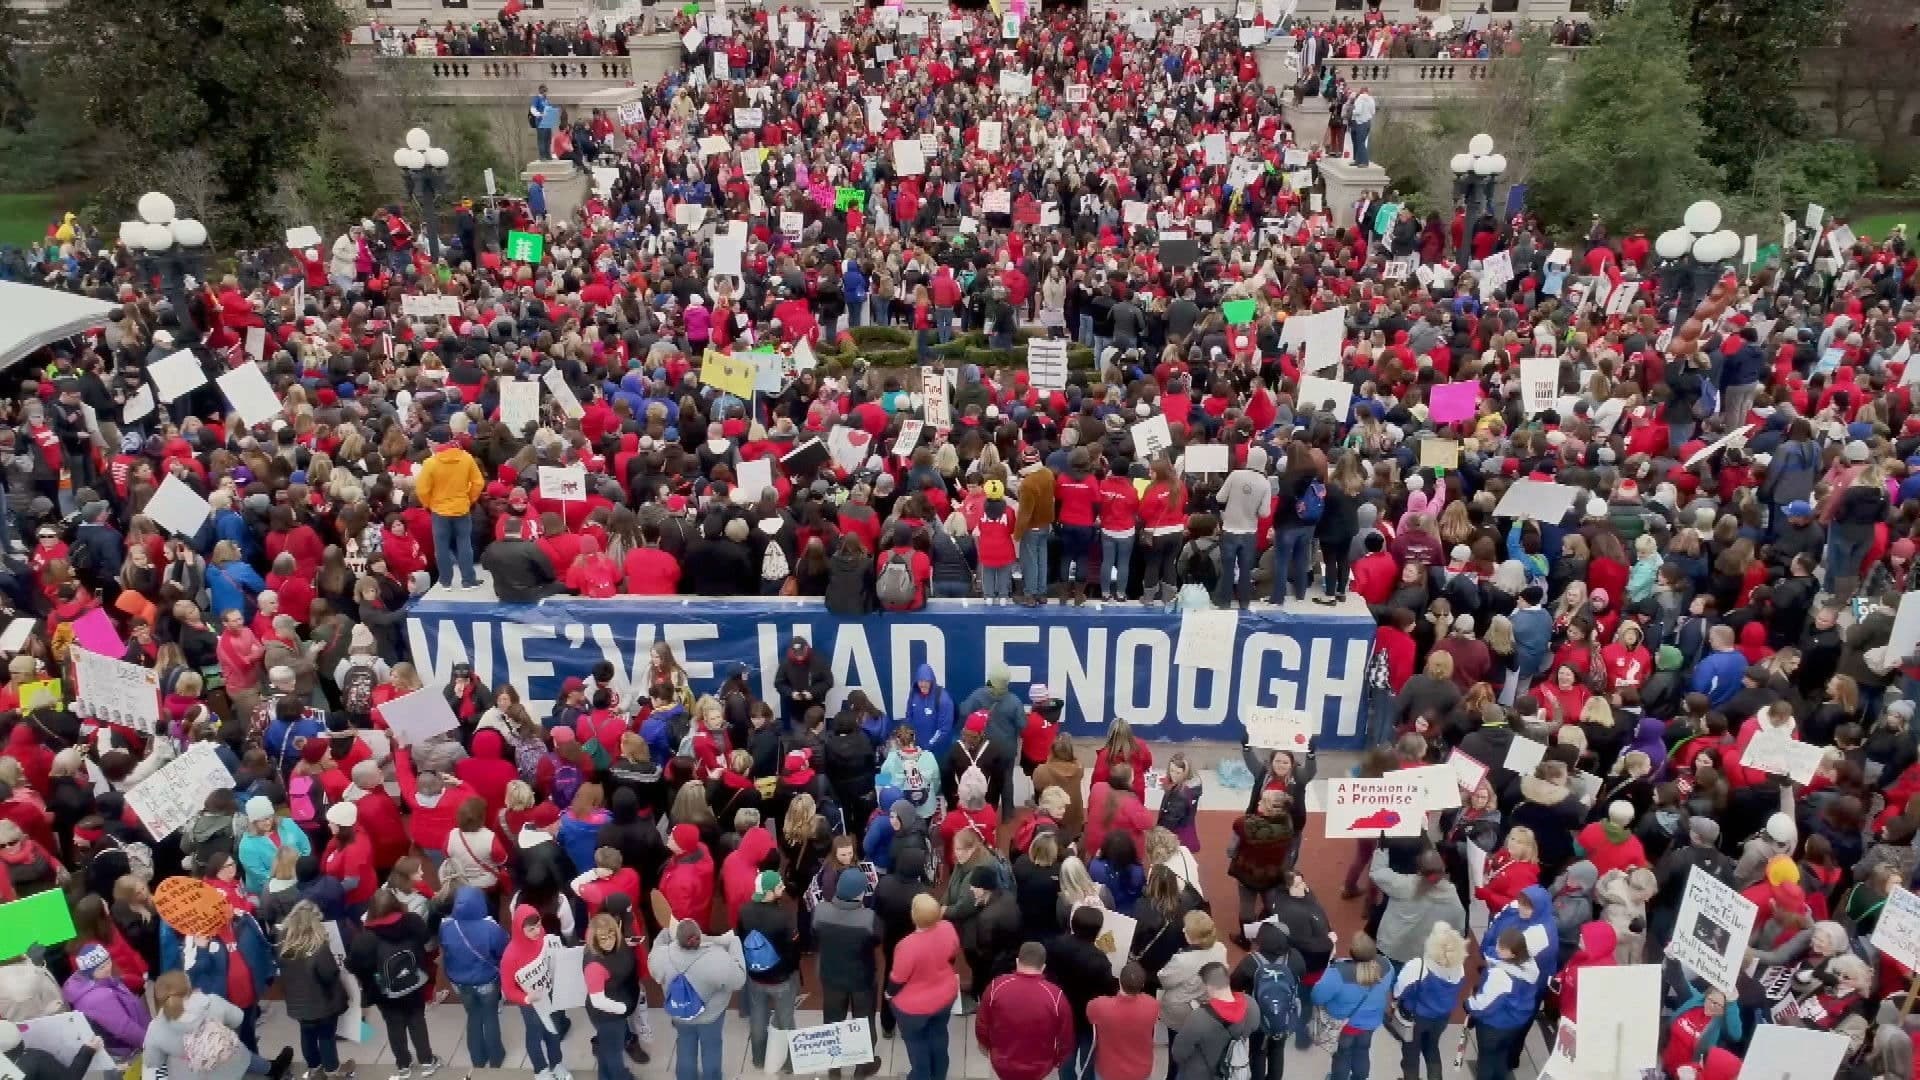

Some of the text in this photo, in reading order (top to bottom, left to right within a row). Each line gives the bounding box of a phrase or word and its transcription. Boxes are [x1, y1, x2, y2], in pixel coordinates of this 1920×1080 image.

[984, 624, 1368, 738] ENOUGH
[1338, 783, 1418, 793] A Pension is
[1337, 793, 1412, 805] a Promise
